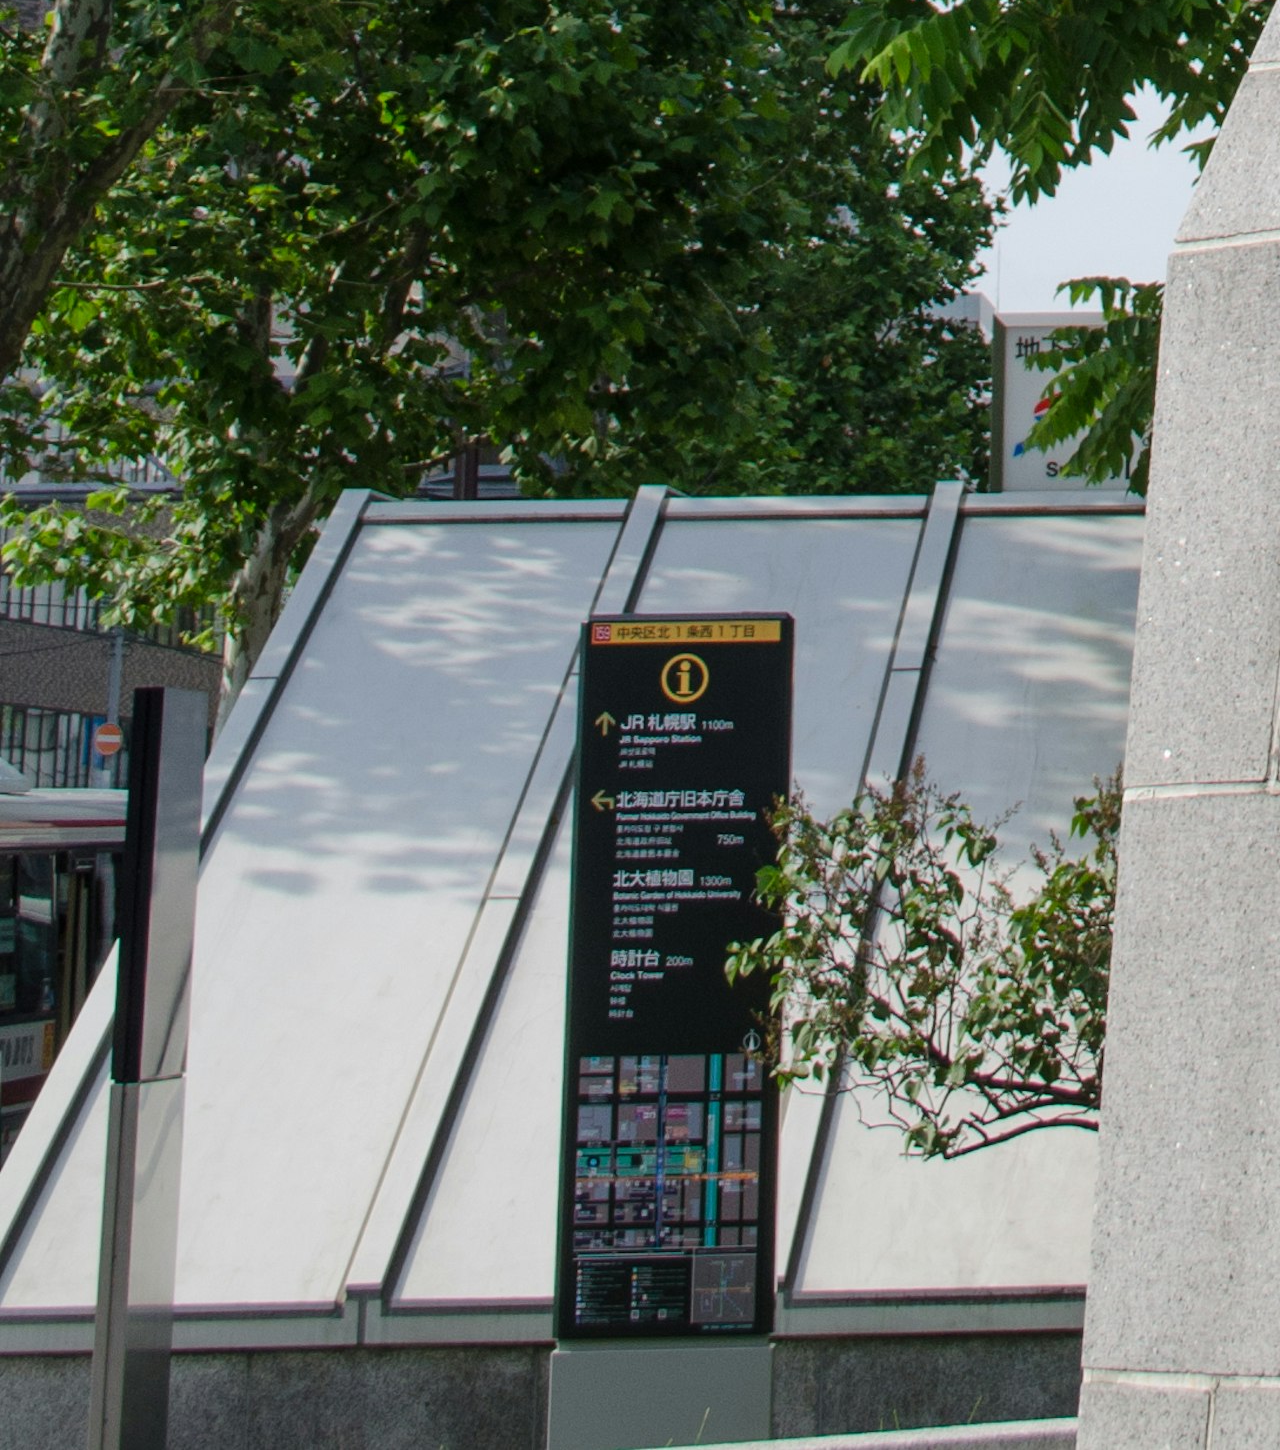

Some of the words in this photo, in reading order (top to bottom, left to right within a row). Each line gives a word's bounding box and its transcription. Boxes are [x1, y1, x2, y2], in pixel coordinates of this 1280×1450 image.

[620, 714, 644, 730] JR
[648, 713, 697, 731] 札幌駅
[702, 719, 734, 730] 1100m
[619, 735, 632, 743] JR
[633, 735, 669, 745] Sapporo
[671, 734, 702, 743] Station
[616, 789, 746, 808] 北海道庁旧本庁舎
[716, 833, 744, 845] 750m
[613, 869, 694, 887] 北大植物園
[700, 876, 732, 887] 1300m
[640, 891, 665, 900] Garden
[674, 891, 706, 900] Hokkaido
[707, 891, 742, 901] University
[611, 949, 660, 967] 時計台
[666, 956, 694, 967] 200m
[610, 971, 635, 980] Clock
[637, 971, 665, 979] Tower
